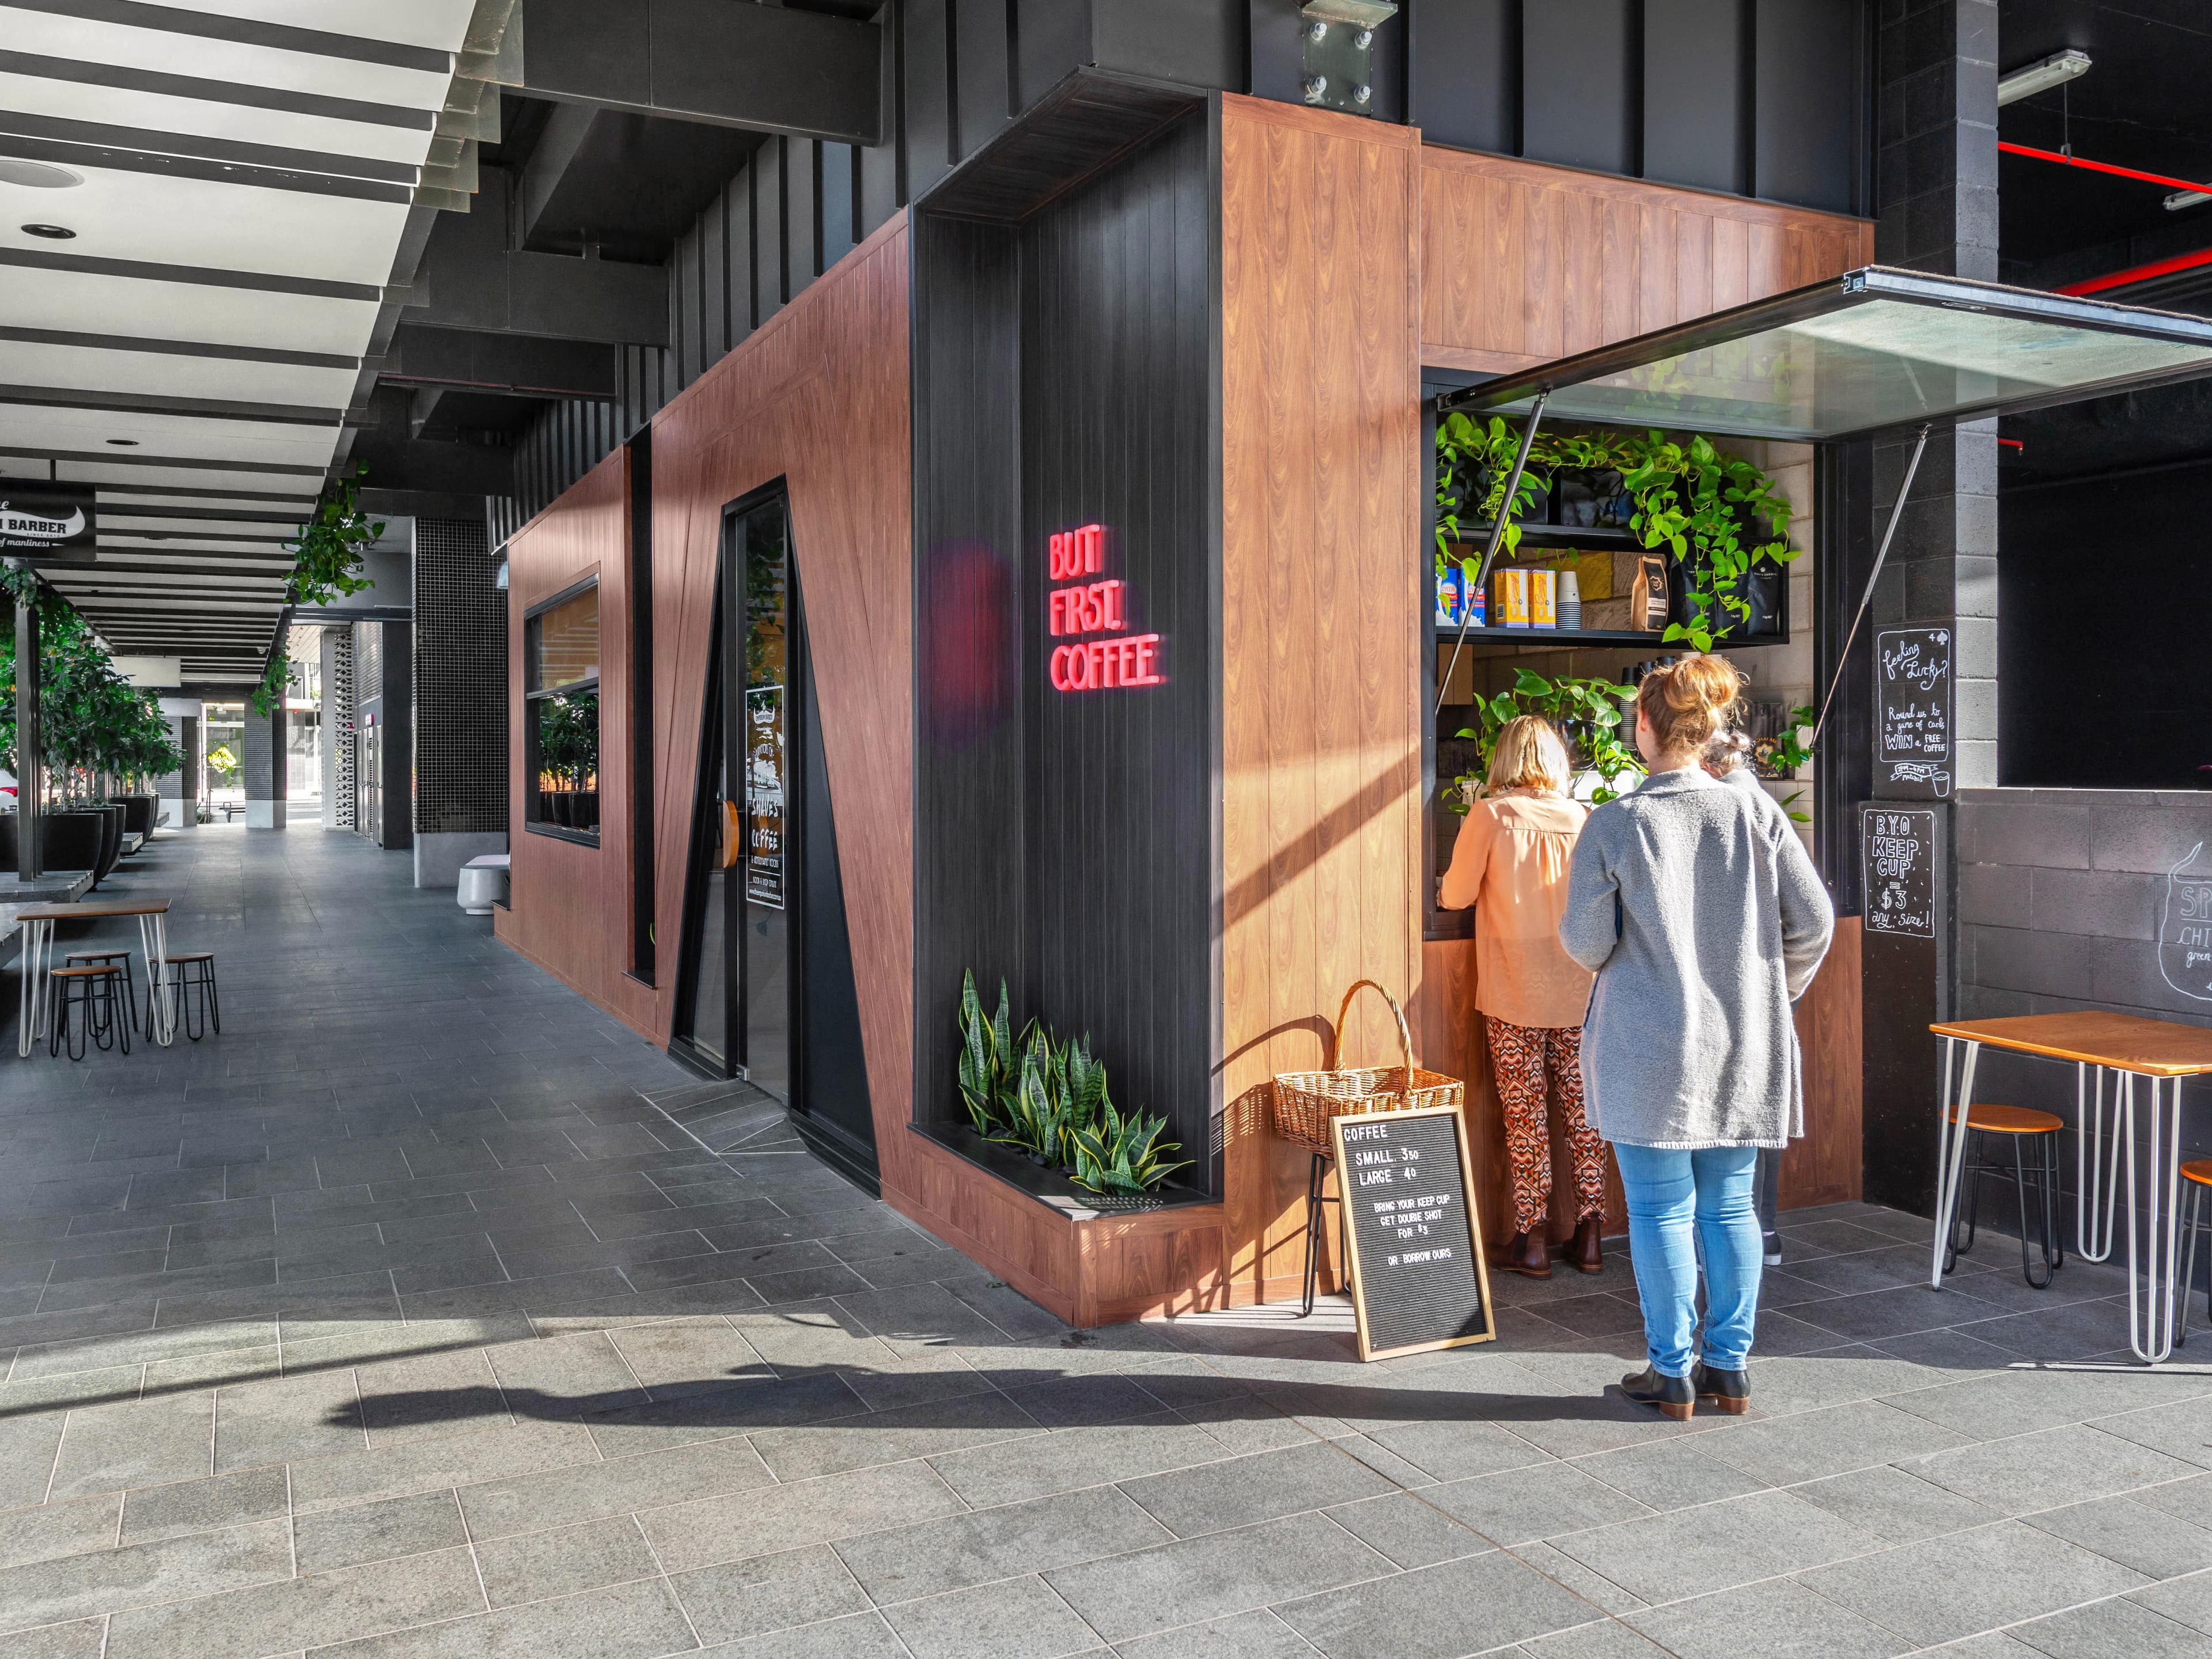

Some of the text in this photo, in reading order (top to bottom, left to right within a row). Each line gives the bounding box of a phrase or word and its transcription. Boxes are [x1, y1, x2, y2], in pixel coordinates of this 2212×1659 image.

[8, 519, 67, 534] BARBER
[7, 539, 50, 547] manliness
[1050, 524, 1101, 580] BUT
[1928, 633, 1936, 642] 4
[1050, 633, 1160, 691] COFFEE
[1882, 641, 1920, 680] feeling
[1907, 658, 1948, 691] Lucky?
[1888, 703, 1915, 721] Round
[1931, 702, 1941, 716] to
[1885, 717, 1945, 734] a game of cards
[1885, 734, 1913, 750] WIN
[1925, 734, 1941, 743] FREE
[1924, 744, 1945, 752] COFFEE
[1902, 774, 1923, 782] matches
[751, 794, 778, 821] SHAVES
[751, 828, 778, 851] COFFEE
[1872, 836, 1919, 861] KEEP
[1877, 858, 1911, 879] CUP
[1872, 911, 1929, 929] any size!
[2187, 952, 2211, 968] green
[1343, 1124, 1388, 1142] COFFEE
[1400, 1147, 1419, 1161] 350
[1358, 1167, 1416, 1187] LARGE 40
[1373, 1194, 1450, 1213] BRING YOUR KEEP CUP
[1380, 1215, 1395, 1226] GET
[1424, 1210, 1442, 1221] SHOT
[1397, 1223, 1429, 1238] FOR $3
[1388, 1248, 1452, 1266] OR BORROW OURS
